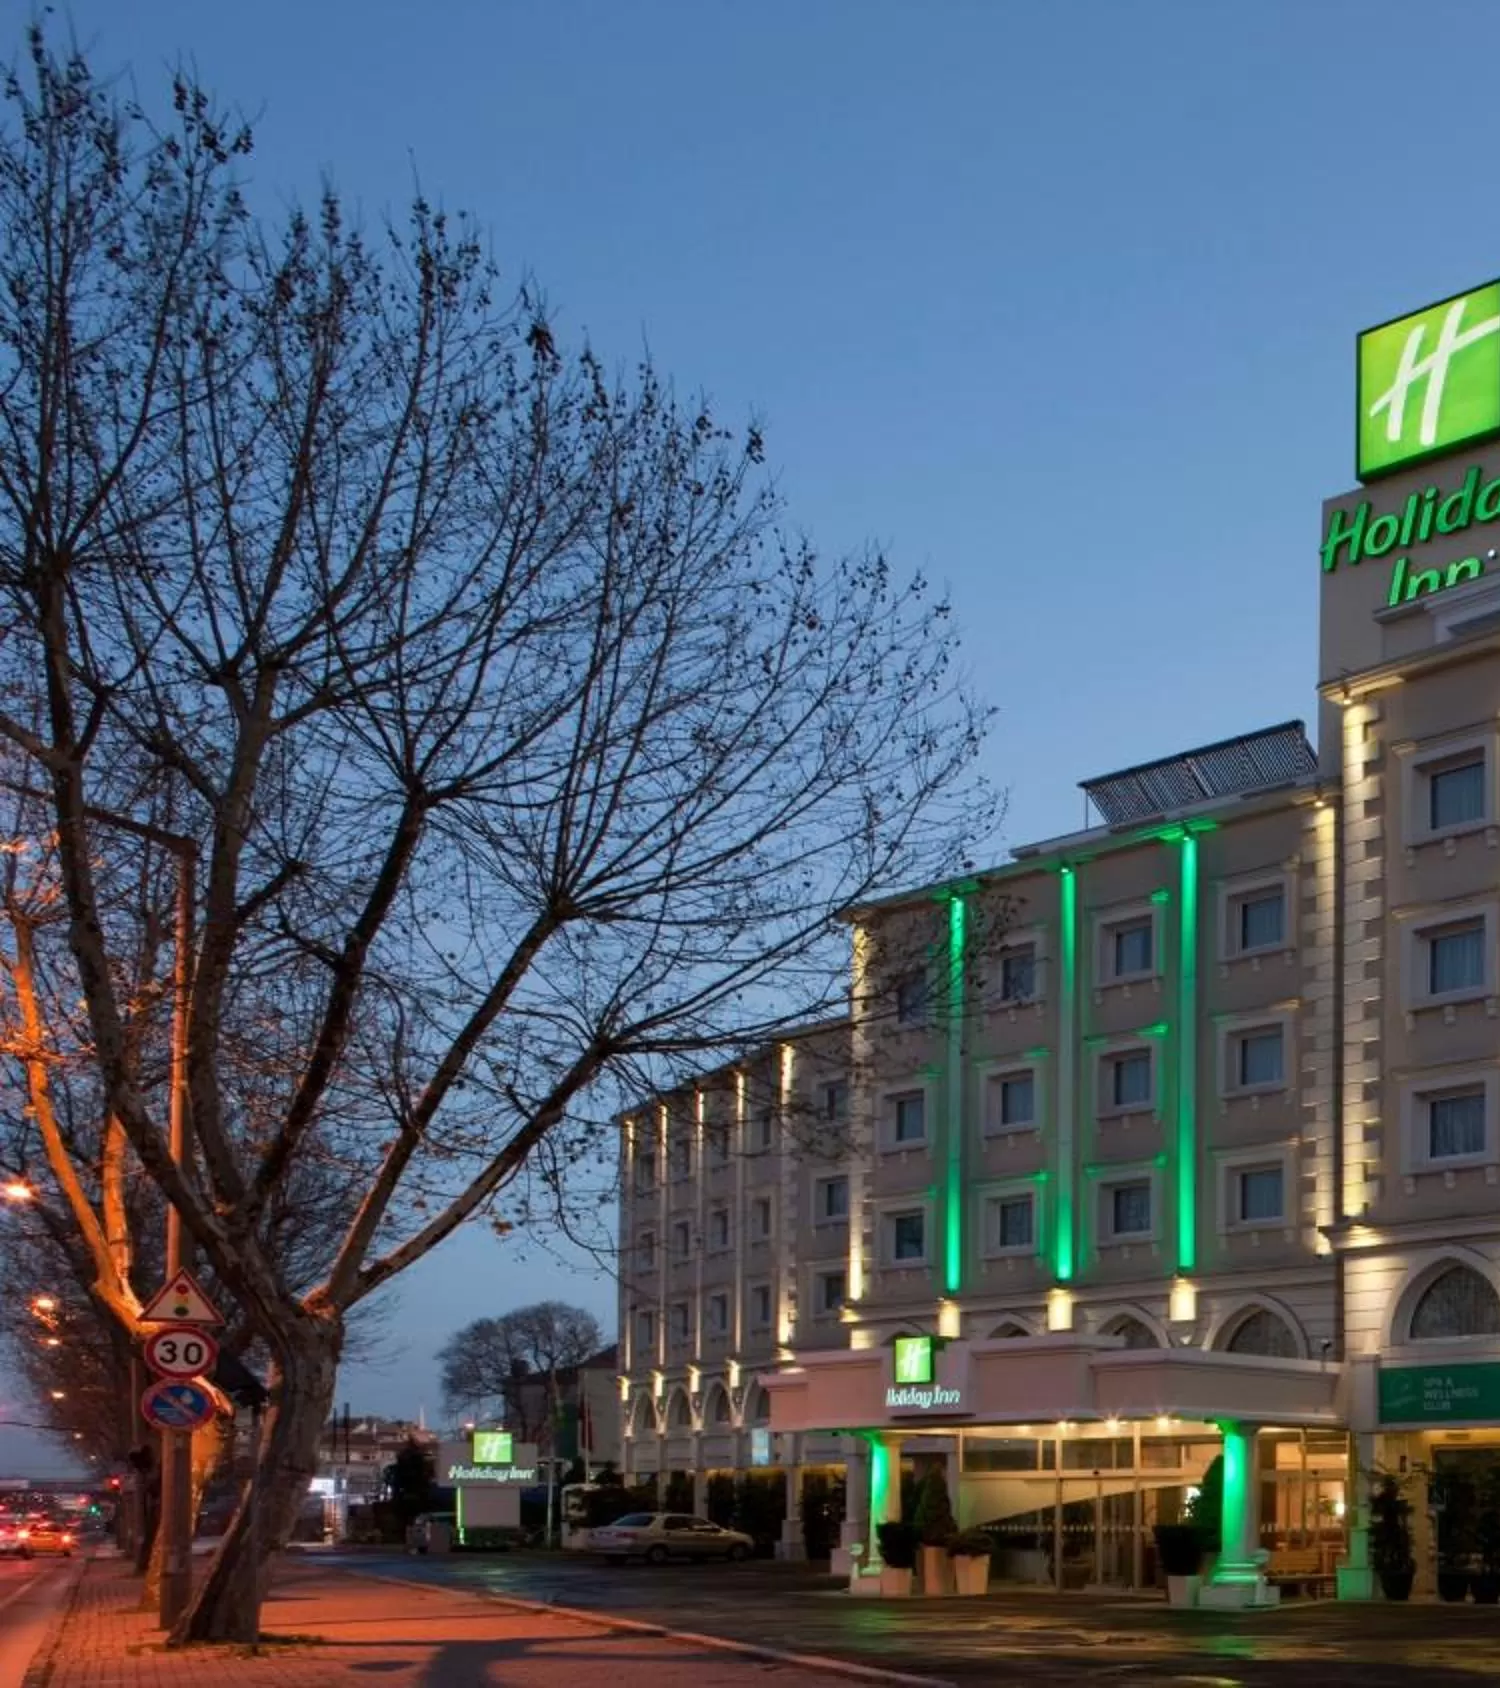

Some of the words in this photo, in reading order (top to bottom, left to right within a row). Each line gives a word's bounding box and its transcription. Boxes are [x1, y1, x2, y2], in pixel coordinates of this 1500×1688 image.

[1387, 557, 1484, 608] Inn
[159, 1340, 203, 1366] 30
[886, 1386, 933, 1409] Holiday
[933, 1384, 961, 1404] Inn
[448, 1465, 509, 1482] Holiday
[509, 1465, 535, 1480] Inn
